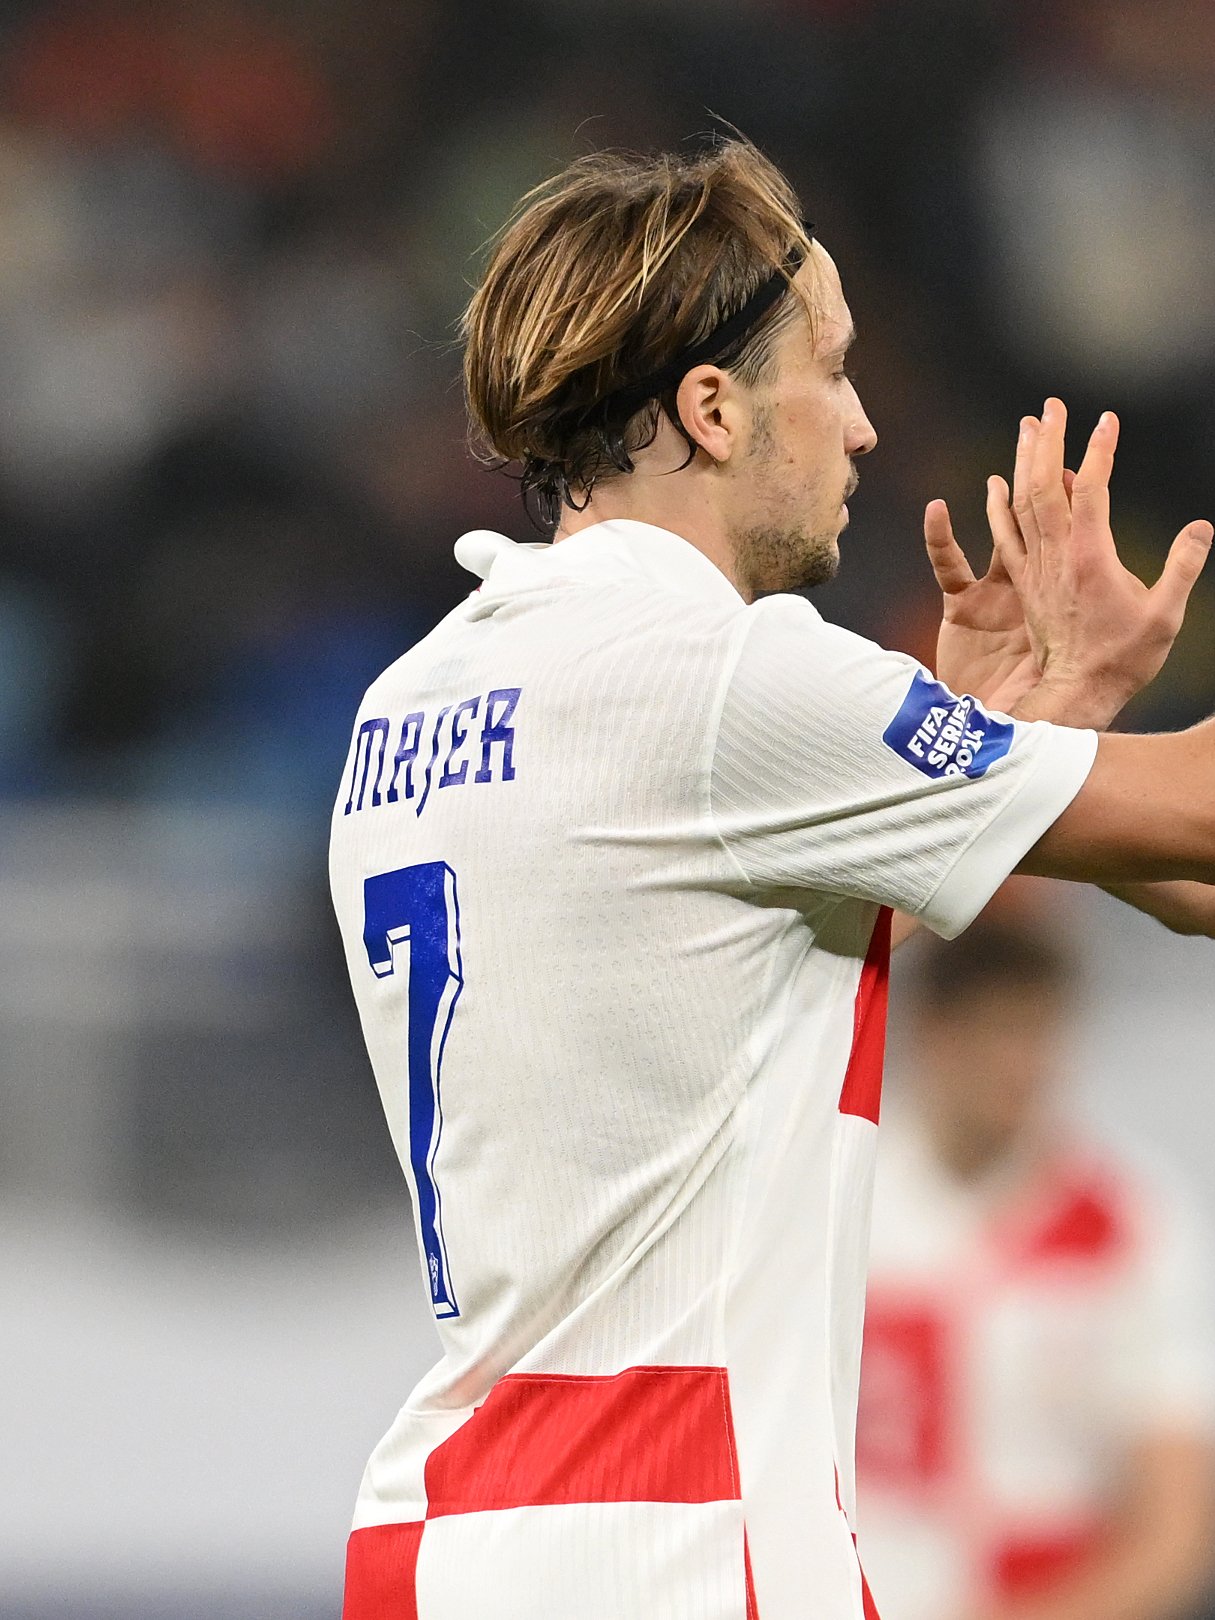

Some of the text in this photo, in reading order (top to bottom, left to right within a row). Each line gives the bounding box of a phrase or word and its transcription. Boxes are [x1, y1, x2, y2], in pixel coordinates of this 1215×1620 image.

[344, 688, 522, 818] MAJER
[907, 706, 948, 757] FIFA
[363, 860, 464, 1320] 7
